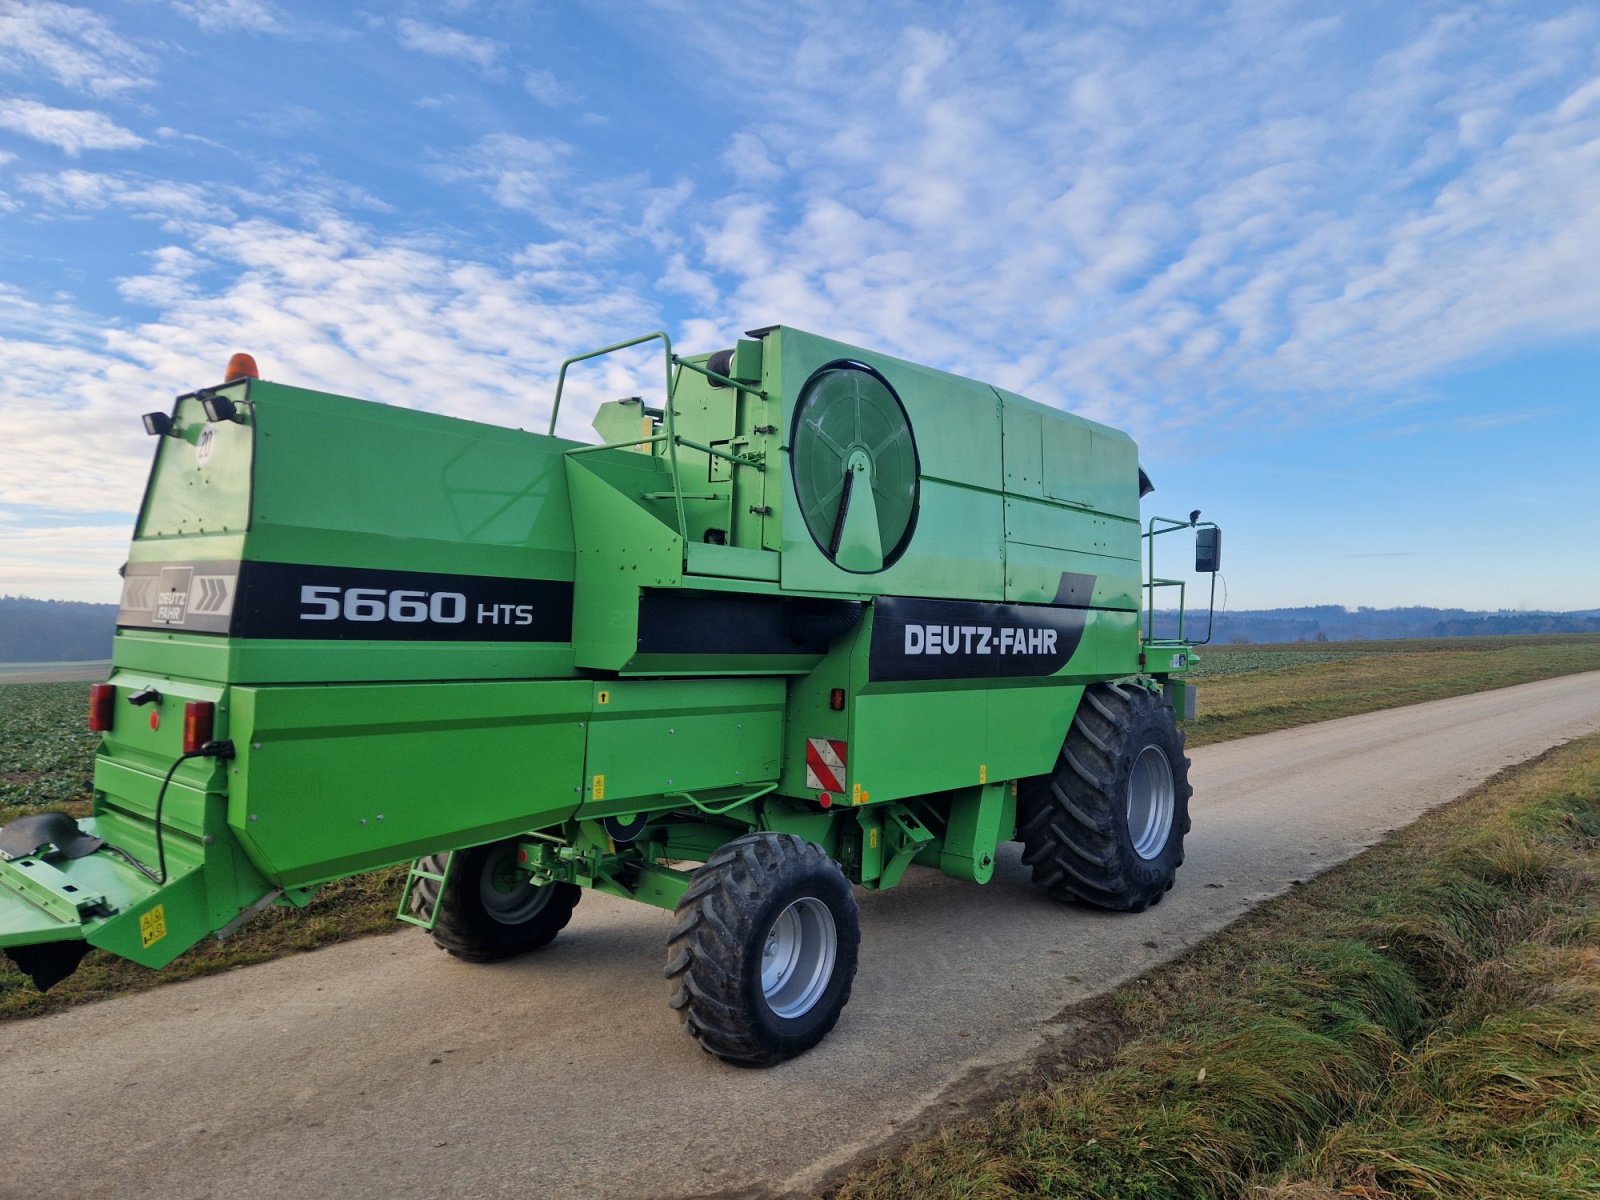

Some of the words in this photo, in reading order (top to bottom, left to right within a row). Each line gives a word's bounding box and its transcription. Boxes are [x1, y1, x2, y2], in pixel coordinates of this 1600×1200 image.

[157, 592, 186, 605] DEUTZ
[300, 585, 467, 624] 5660
[477, 603, 533, 625] HTS
[157, 606, 181, 620] FAHR
